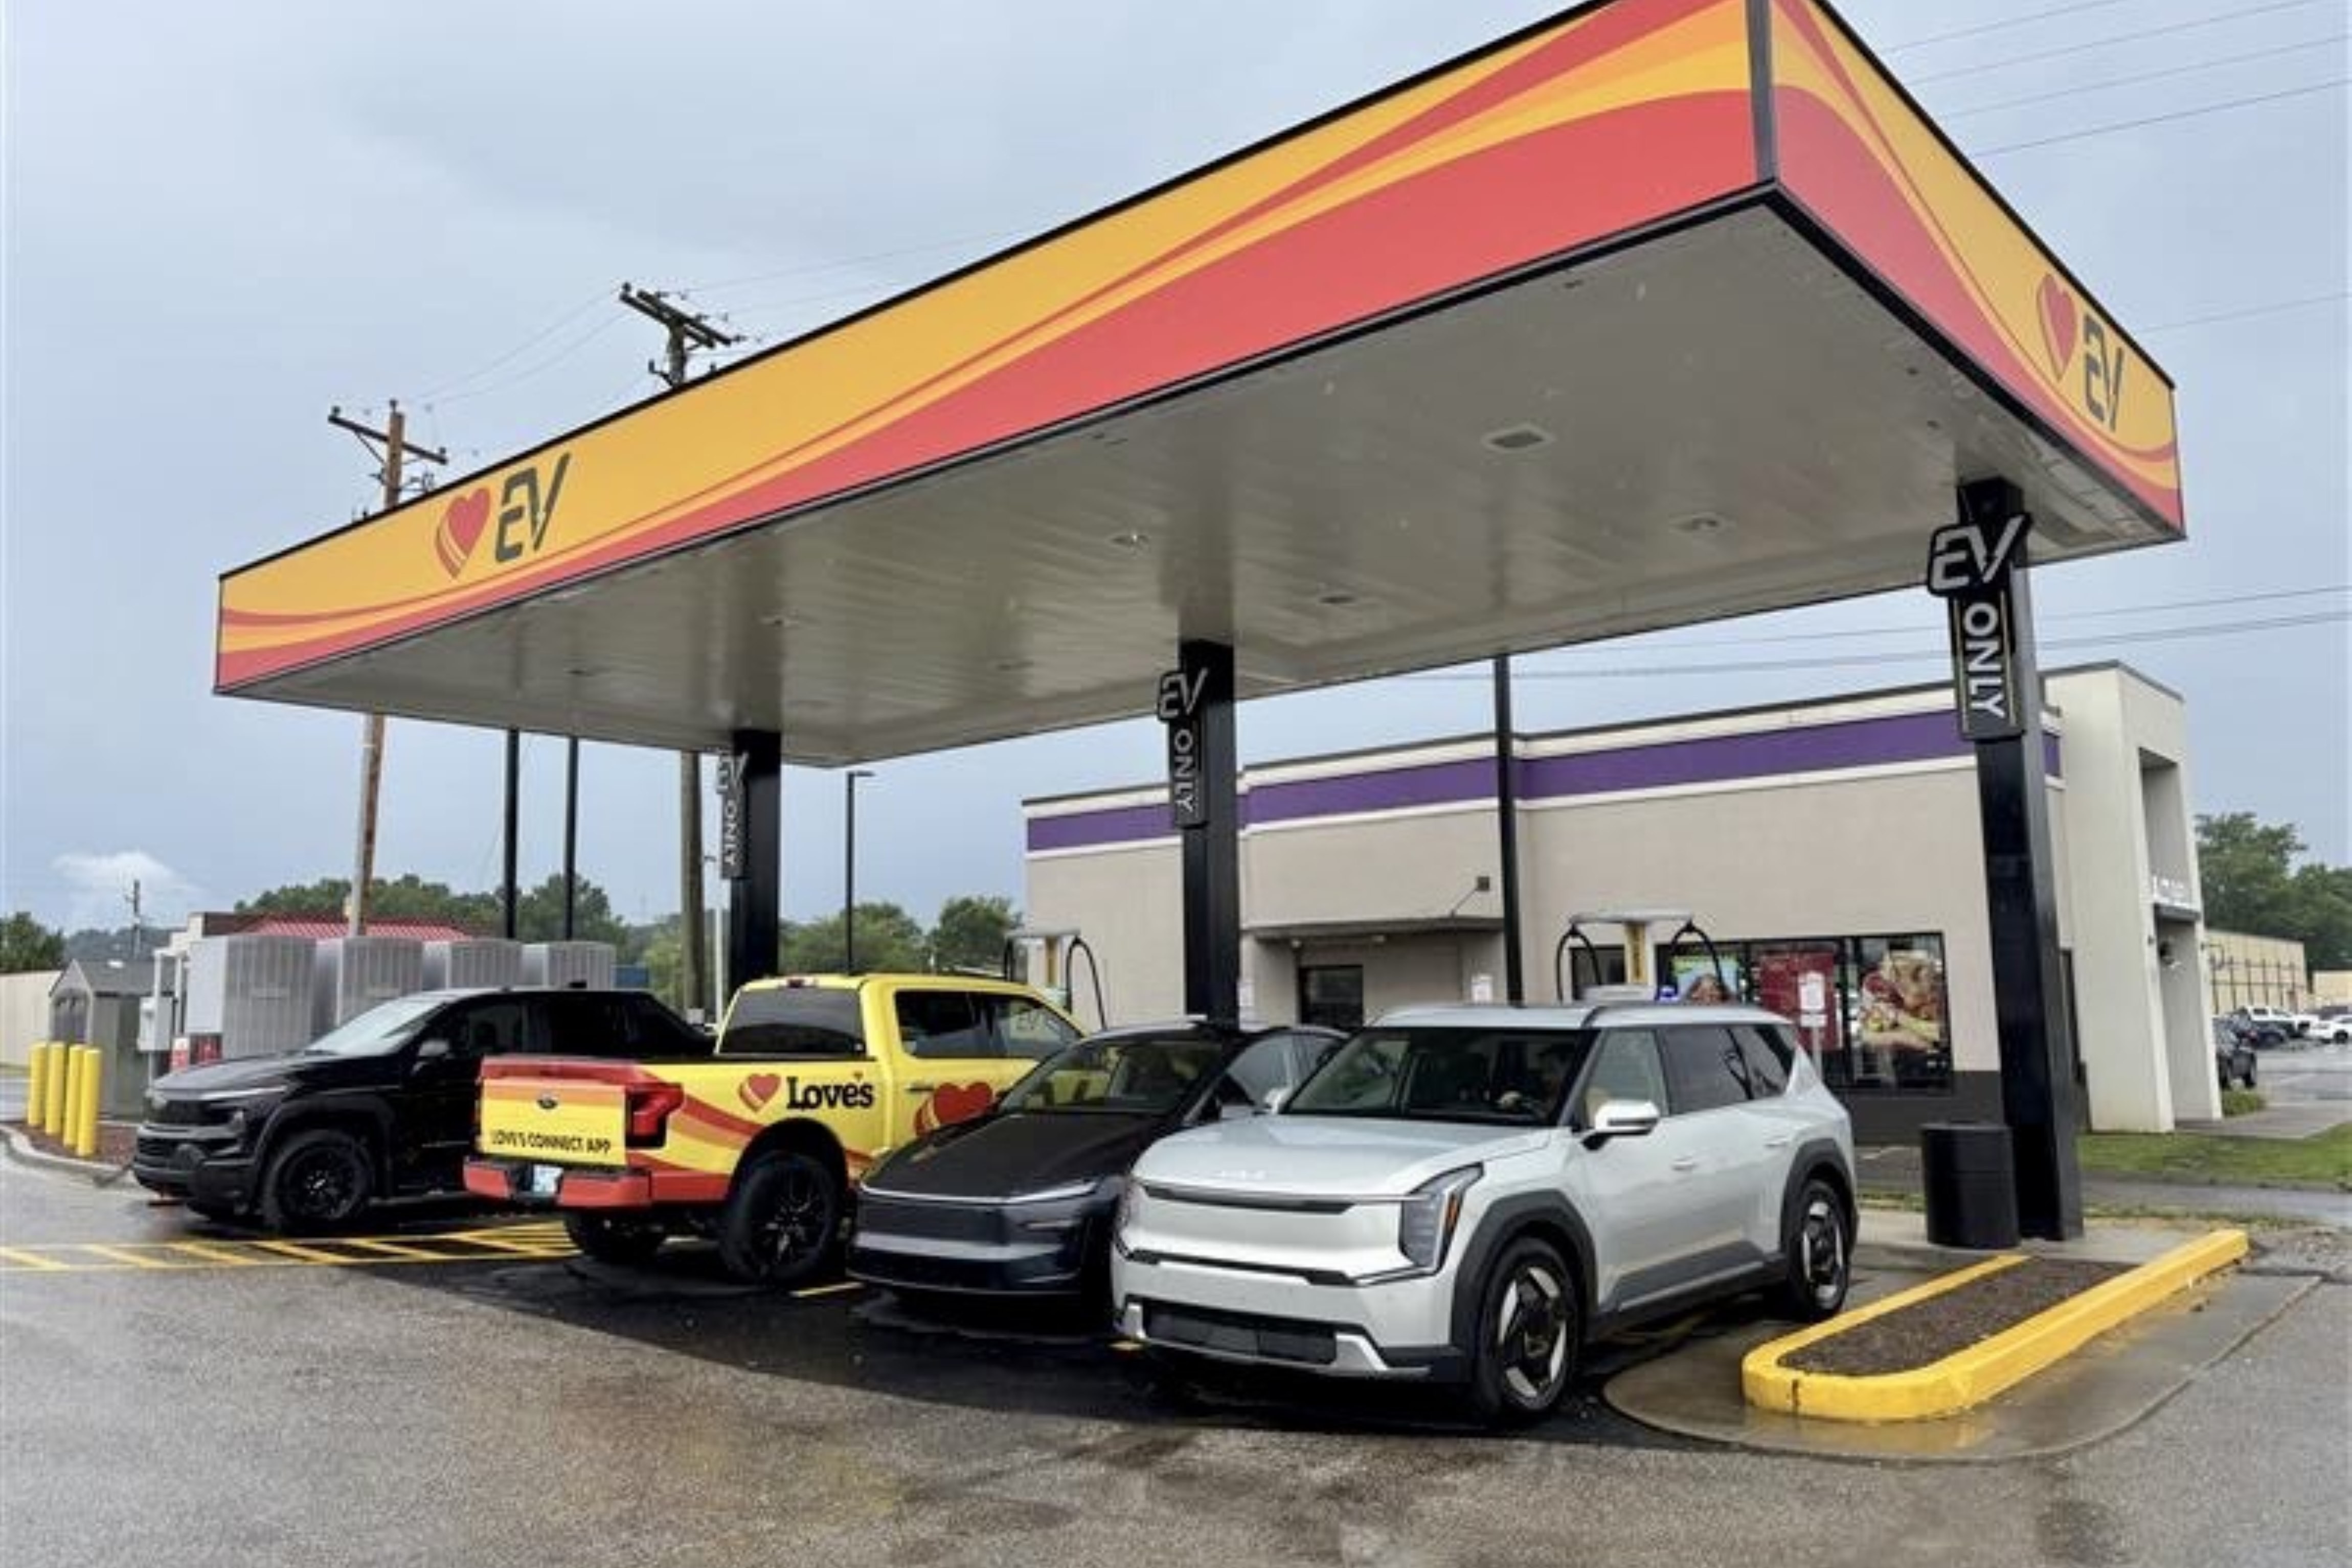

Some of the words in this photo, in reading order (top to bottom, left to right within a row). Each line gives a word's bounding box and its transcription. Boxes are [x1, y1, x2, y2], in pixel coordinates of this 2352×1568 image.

[2083, 313, 2123, 433] EV
[495, 452, 570, 562] EV
[1931, 514, 2024, 590] EV
[1159, 667, 1208, 717] EV
[1964, 602, 2005, 718] ONLY
[1174, 729, 1193, 812] ONLY
[725, 799, 738, 866] ONLY
[587, 1138, 611, 1154] APP
